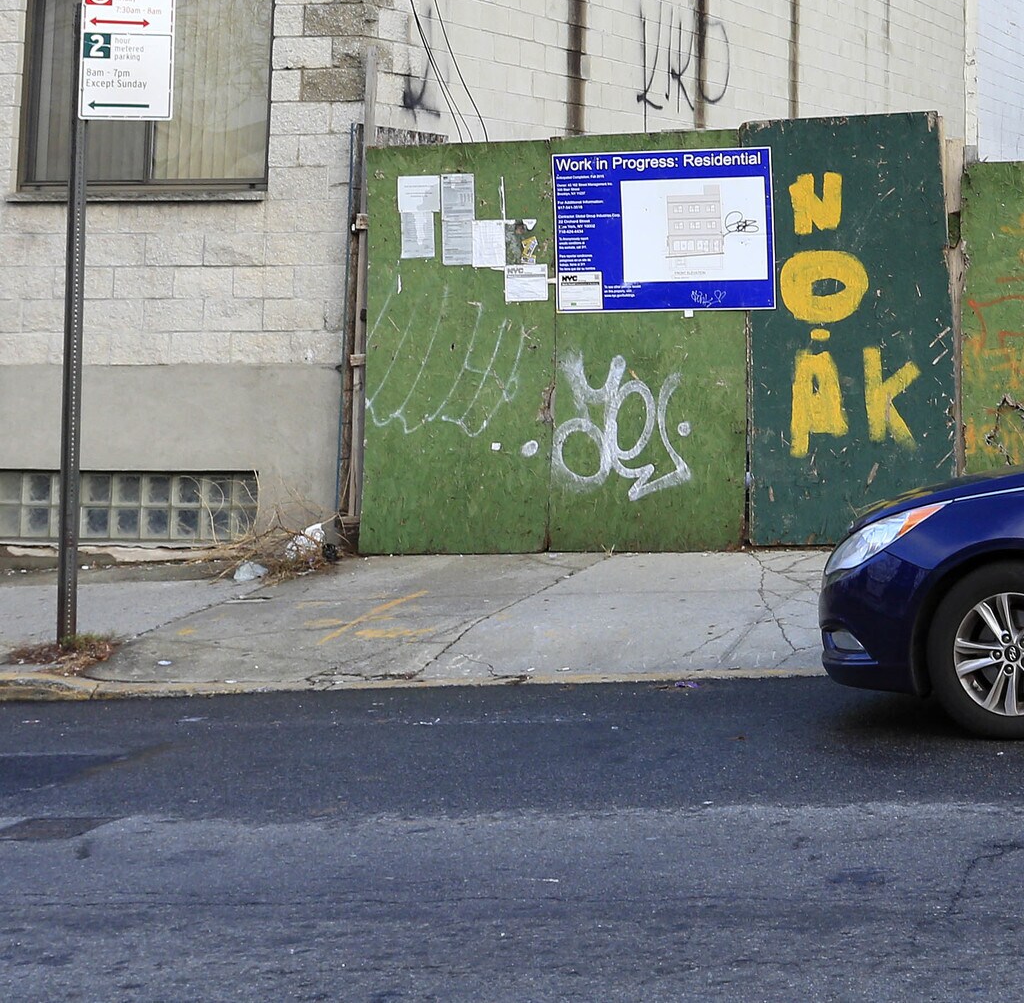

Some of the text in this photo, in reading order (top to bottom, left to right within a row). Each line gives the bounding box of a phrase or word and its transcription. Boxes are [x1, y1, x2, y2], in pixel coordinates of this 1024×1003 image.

[116, 5, 140, 14] 7:30am
[148, 7, 162, 15] 8am
[90, 35, 104, 57] 2
[114, 45, 144, 53] metered
[114, 53, 140, 61] parking
[86, 69, 104, 77] 8am
[114, 69, 130, 79] 7pm
[86, 79, 147, 89] Except Sunday
[556, 152, 761, 172] Work in Progress: Residential
